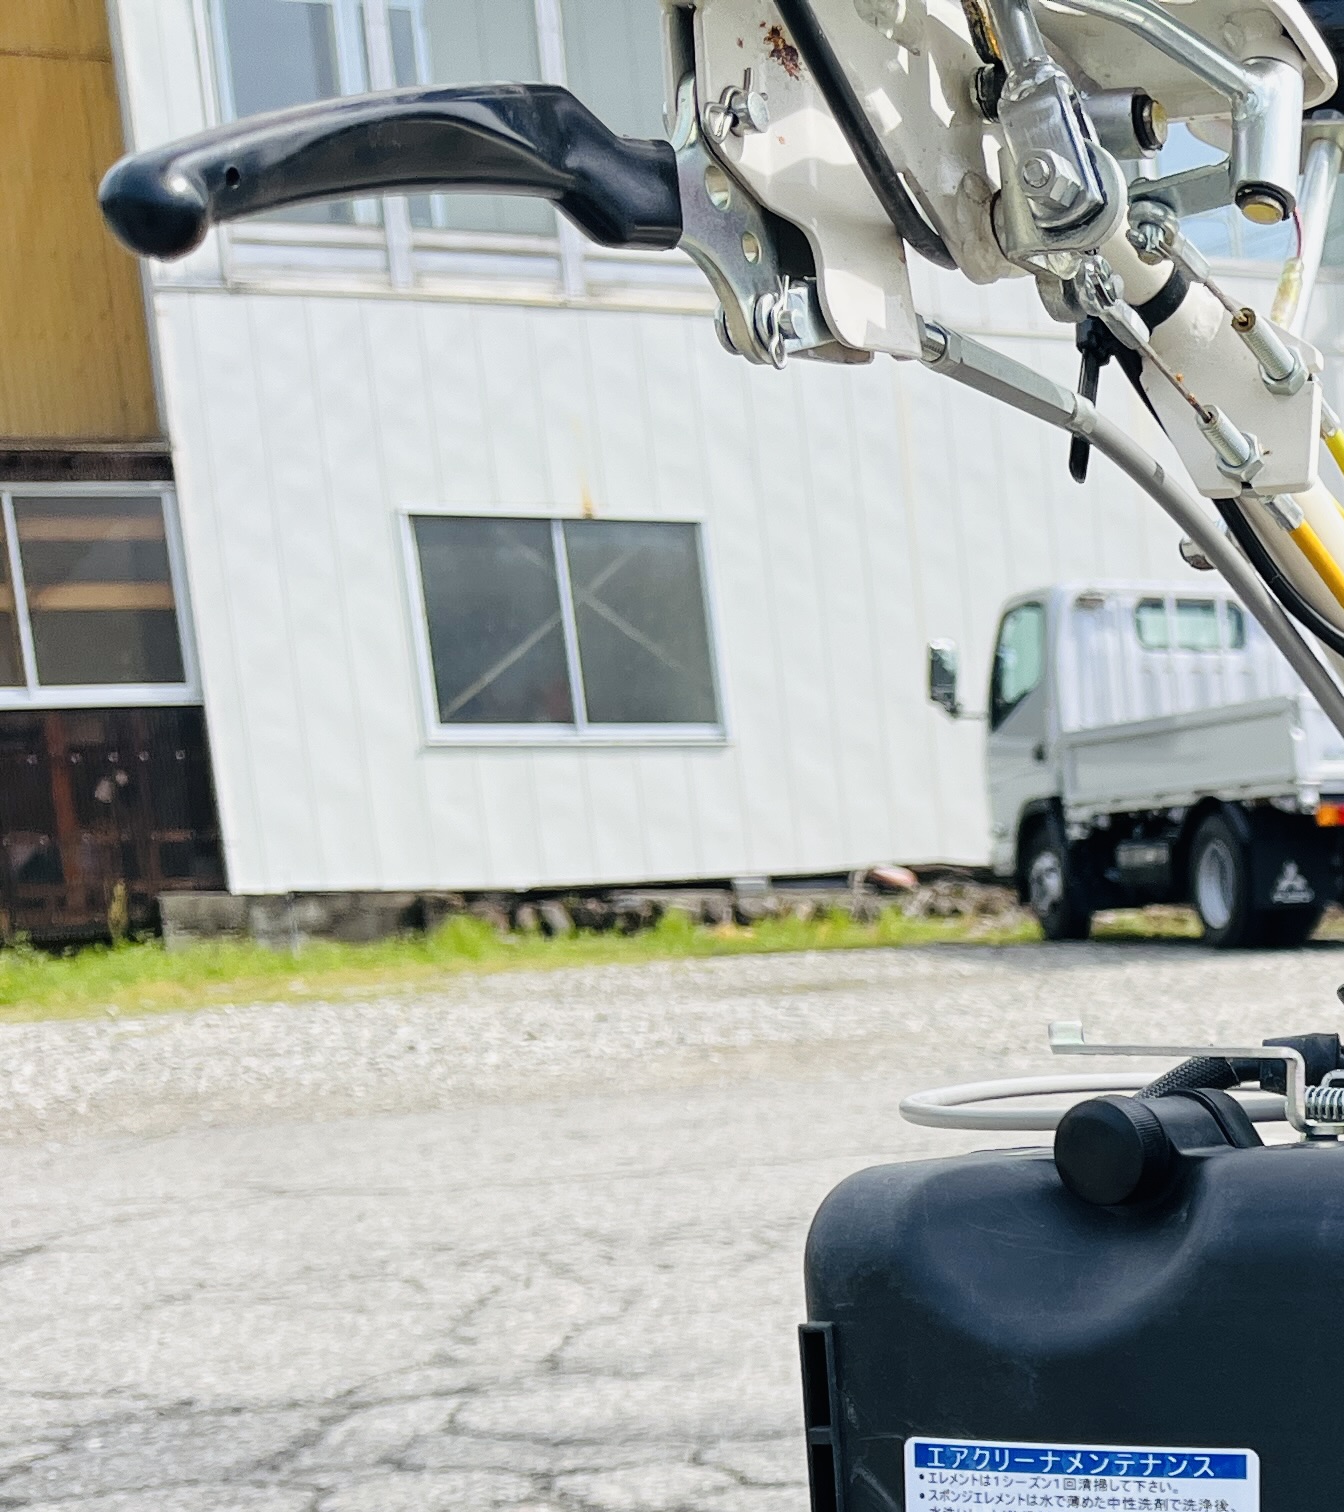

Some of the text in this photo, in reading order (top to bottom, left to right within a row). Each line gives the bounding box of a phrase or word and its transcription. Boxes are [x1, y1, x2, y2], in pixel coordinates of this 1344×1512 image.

[927, 1447, 1215, 1477] エアクリーナメンテナンス
